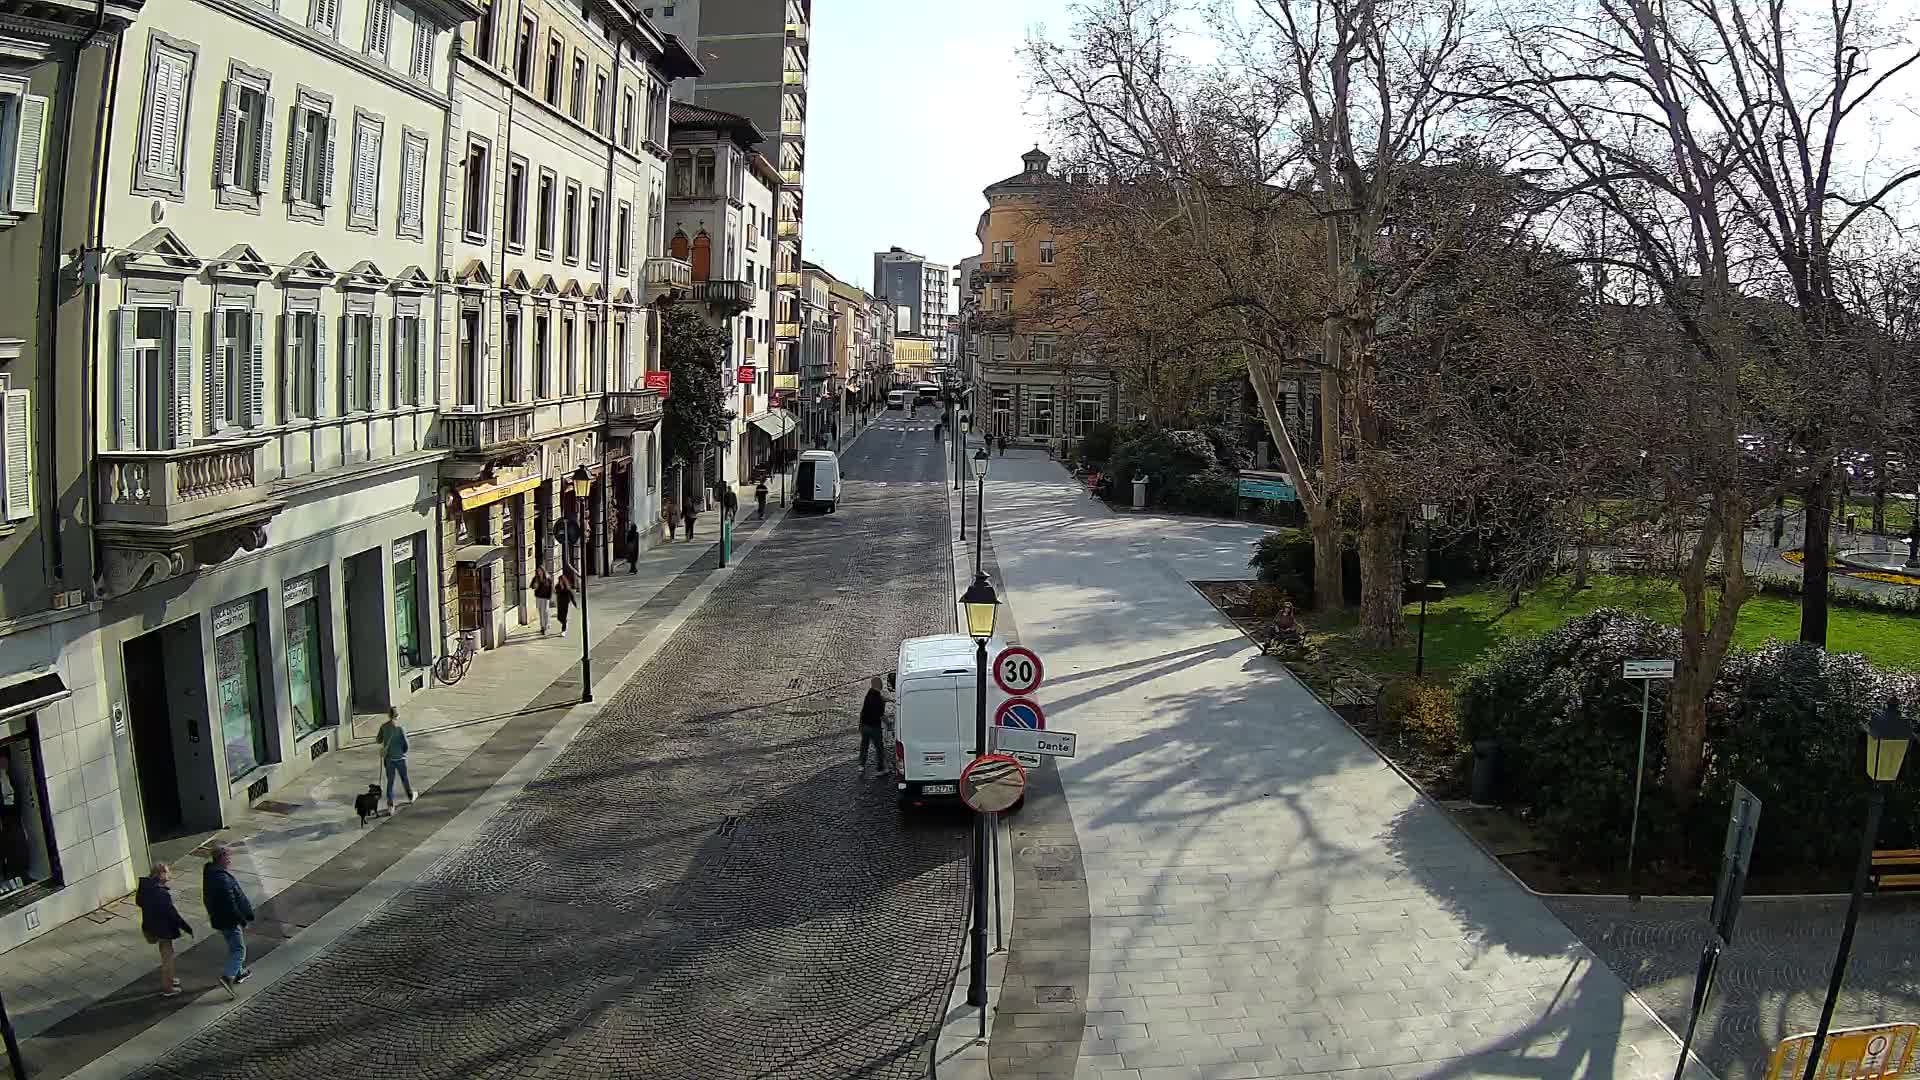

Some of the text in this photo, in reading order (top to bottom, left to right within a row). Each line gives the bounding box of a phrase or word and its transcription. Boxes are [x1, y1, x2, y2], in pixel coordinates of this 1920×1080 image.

[1004, 660, 1032, 683] 30
[221, 679, 240, 702] 130
[1037, 740, 1069, 752] Dante
